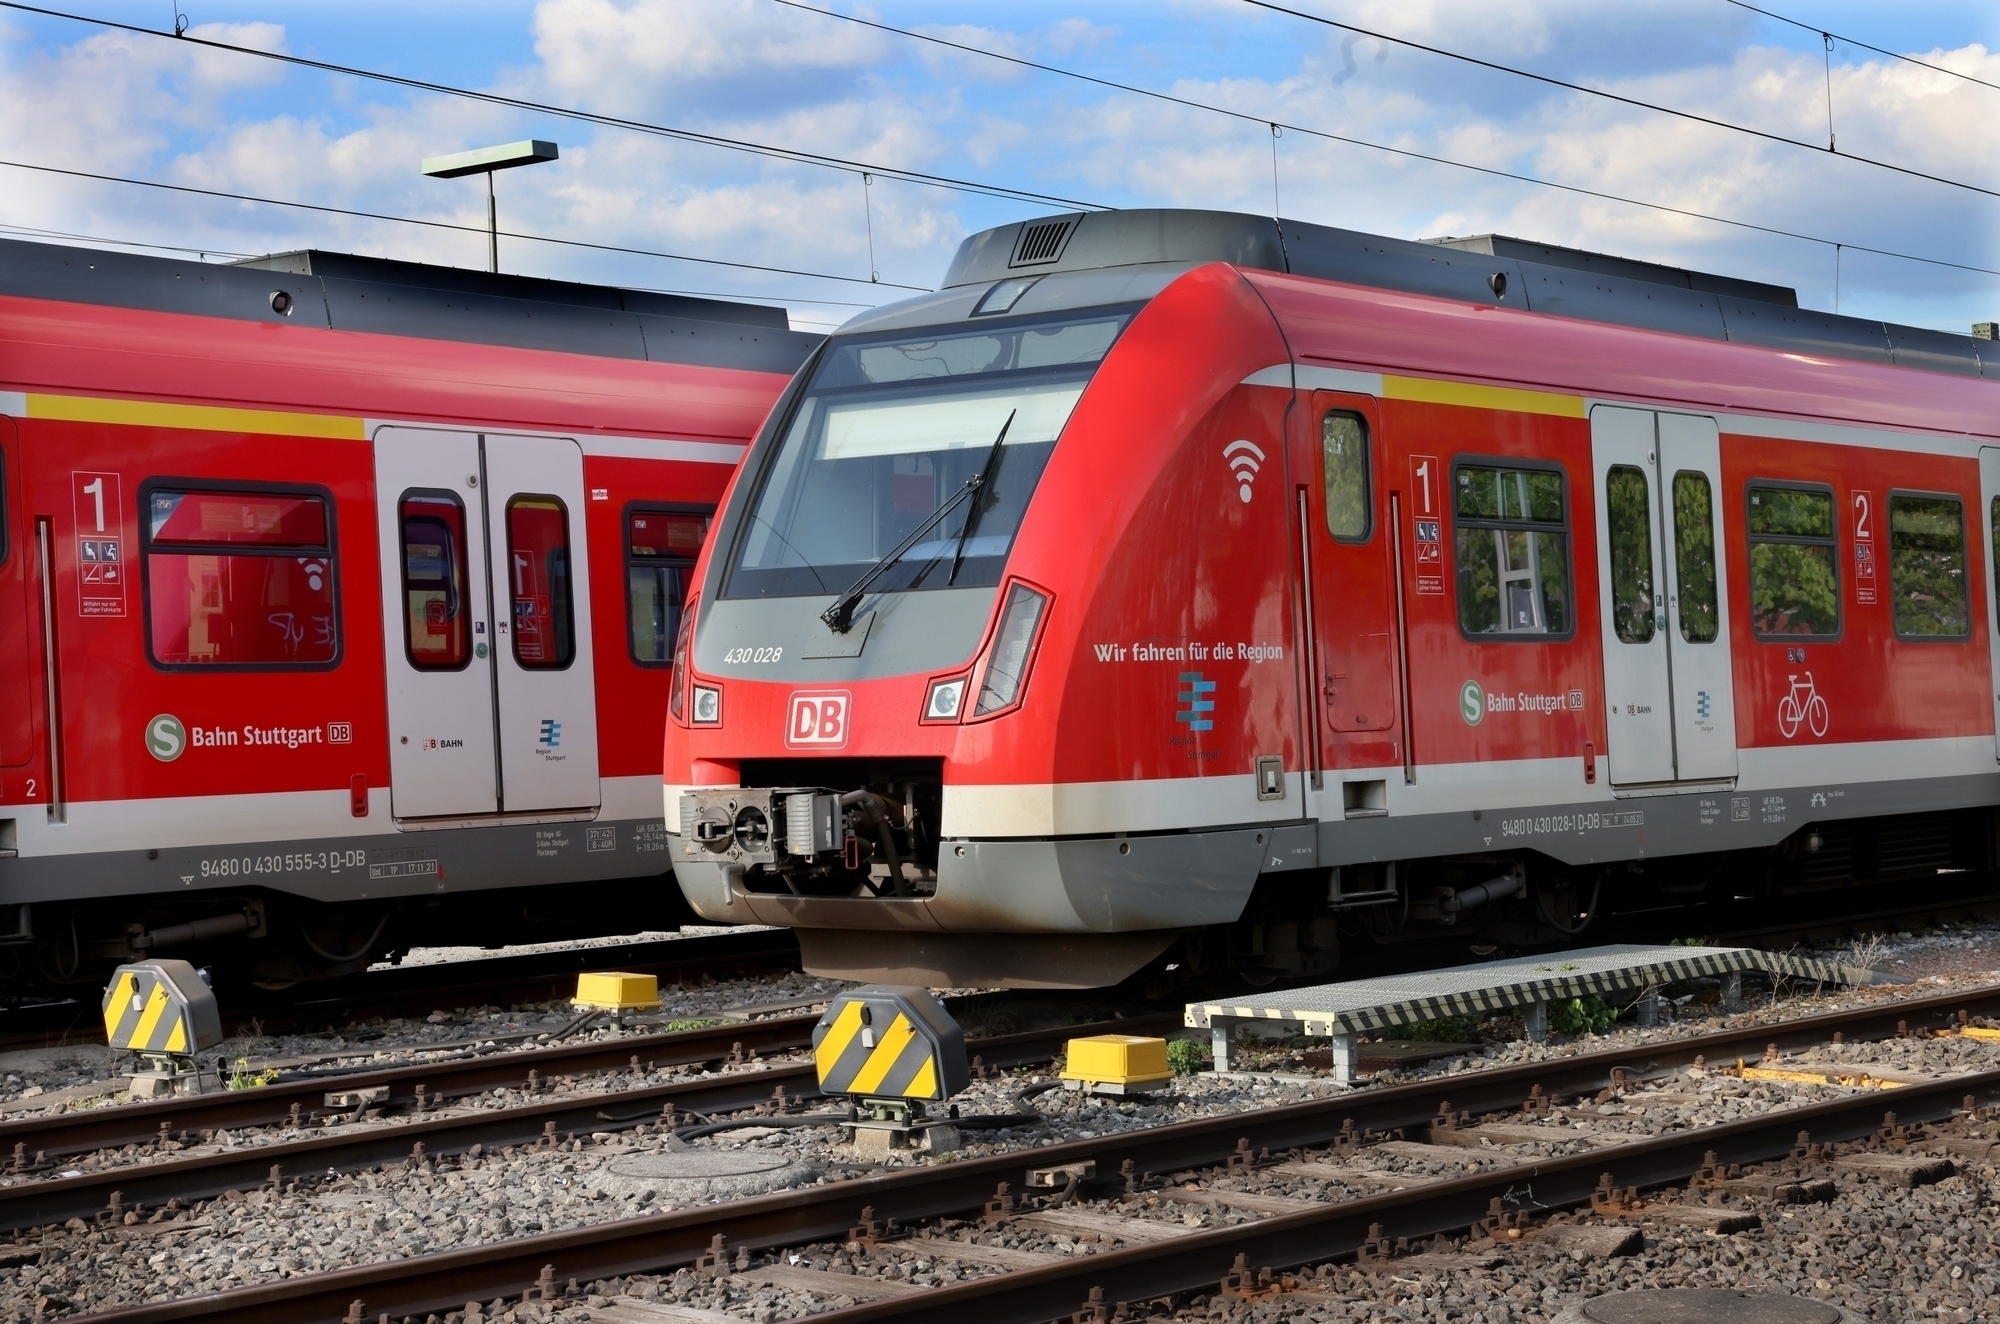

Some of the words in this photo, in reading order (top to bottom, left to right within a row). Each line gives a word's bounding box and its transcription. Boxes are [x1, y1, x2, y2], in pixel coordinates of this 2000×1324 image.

[1416, 461, 1430, 512] 1
[83, 477, 105, 531] 1
[1856, 495, 1869, 537] 2
[724, 648, 752, 664] 430
[753, 647, 783, 663] 028
[1094, 644, 1127, 662] Wir
[1132, 642, 1184, 660] fahren
[1188, 642, 1209, 660] für
[1212, 643, 1233, 660] die
[1238, 642, 1283, 663] Region
[1462, 683, 1482, 722] S
[1487, 692, 1516, 712] Bahn
[1518, 692, 1566, 715] Stuttgart
[1570, 692, 1583, 708] DB
[1627, 704, 1635, 714] DB
[790, 696, 847, 743] DB
[151, 718, 181, 758] S
[192, 726, 238, 747] Bahn
[243, 725, 322, 749] Stuttgart
[330, 724, 350, 742] DB
[440, 739, 463, 748] BAHN
[1169, 735, 1197, 747] Region
[1393, 742, 1398, 759] 1
[26, 778, 36, 797] 2
[1502, 819, 1525, 836] 9480
[1527, 818, 1532, 834] 0
[1534, 817, 1551, 833] 430
[1552, 815, 1576, 832] 028-1
[1578, 813, 1600, 832] D-DB
[201, 859, 238, 877] 9480
[242, 858, 251, 875] 0
[254, 856, 282, 874] 430
[286, 852, 327, 872] 555-3
[330, 850, 366, 871] D-DB
[390, 866, 398, 875] TP
[408, 863, 434, 873] 17.11.21
